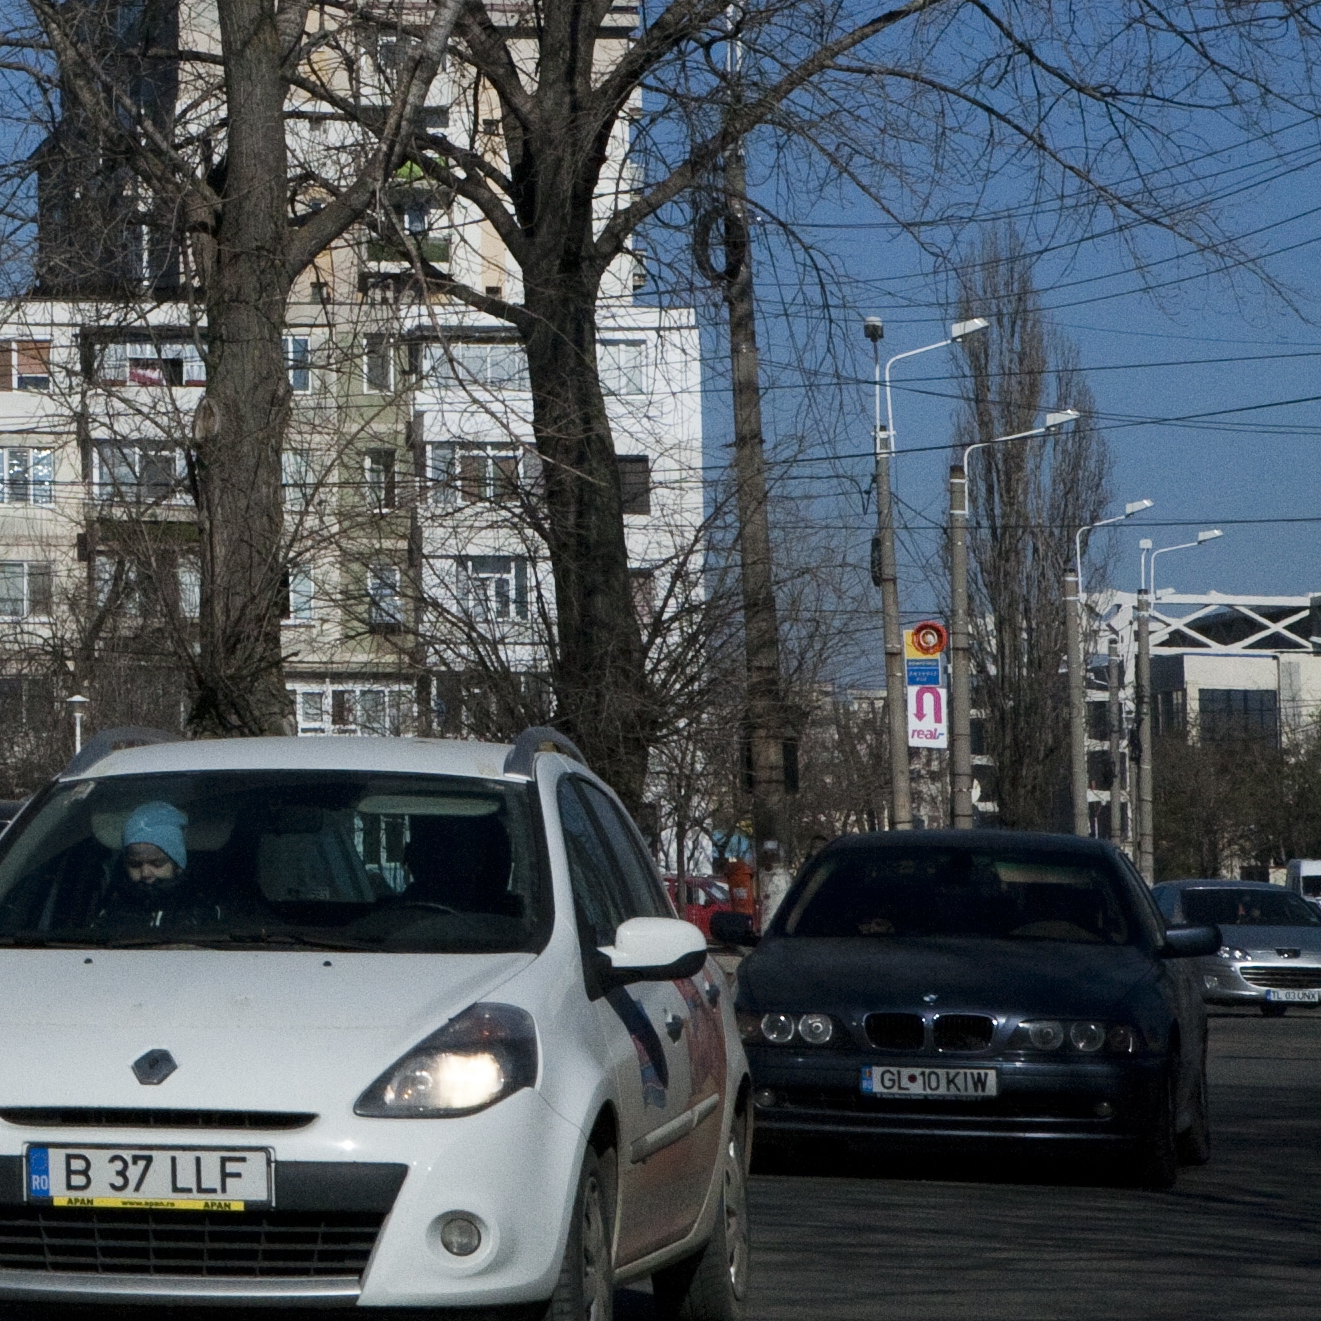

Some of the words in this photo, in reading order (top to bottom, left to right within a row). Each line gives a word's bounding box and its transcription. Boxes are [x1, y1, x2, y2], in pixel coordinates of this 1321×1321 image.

[880, 1069, 910, 1091] GL
[919, 1070, 940, 1092] 10
[946, 1071, 989, 1093] KIW
[32, 1174, 49, 1190] RO
[65, 1153, 92, 1191] B
[108, 1154, 153, 1192] 37
[170, 1155, 247, 1194] LLF
[66, 1198, 94, 1206] APAN
[203, 1201, 232, 1211] APAN
